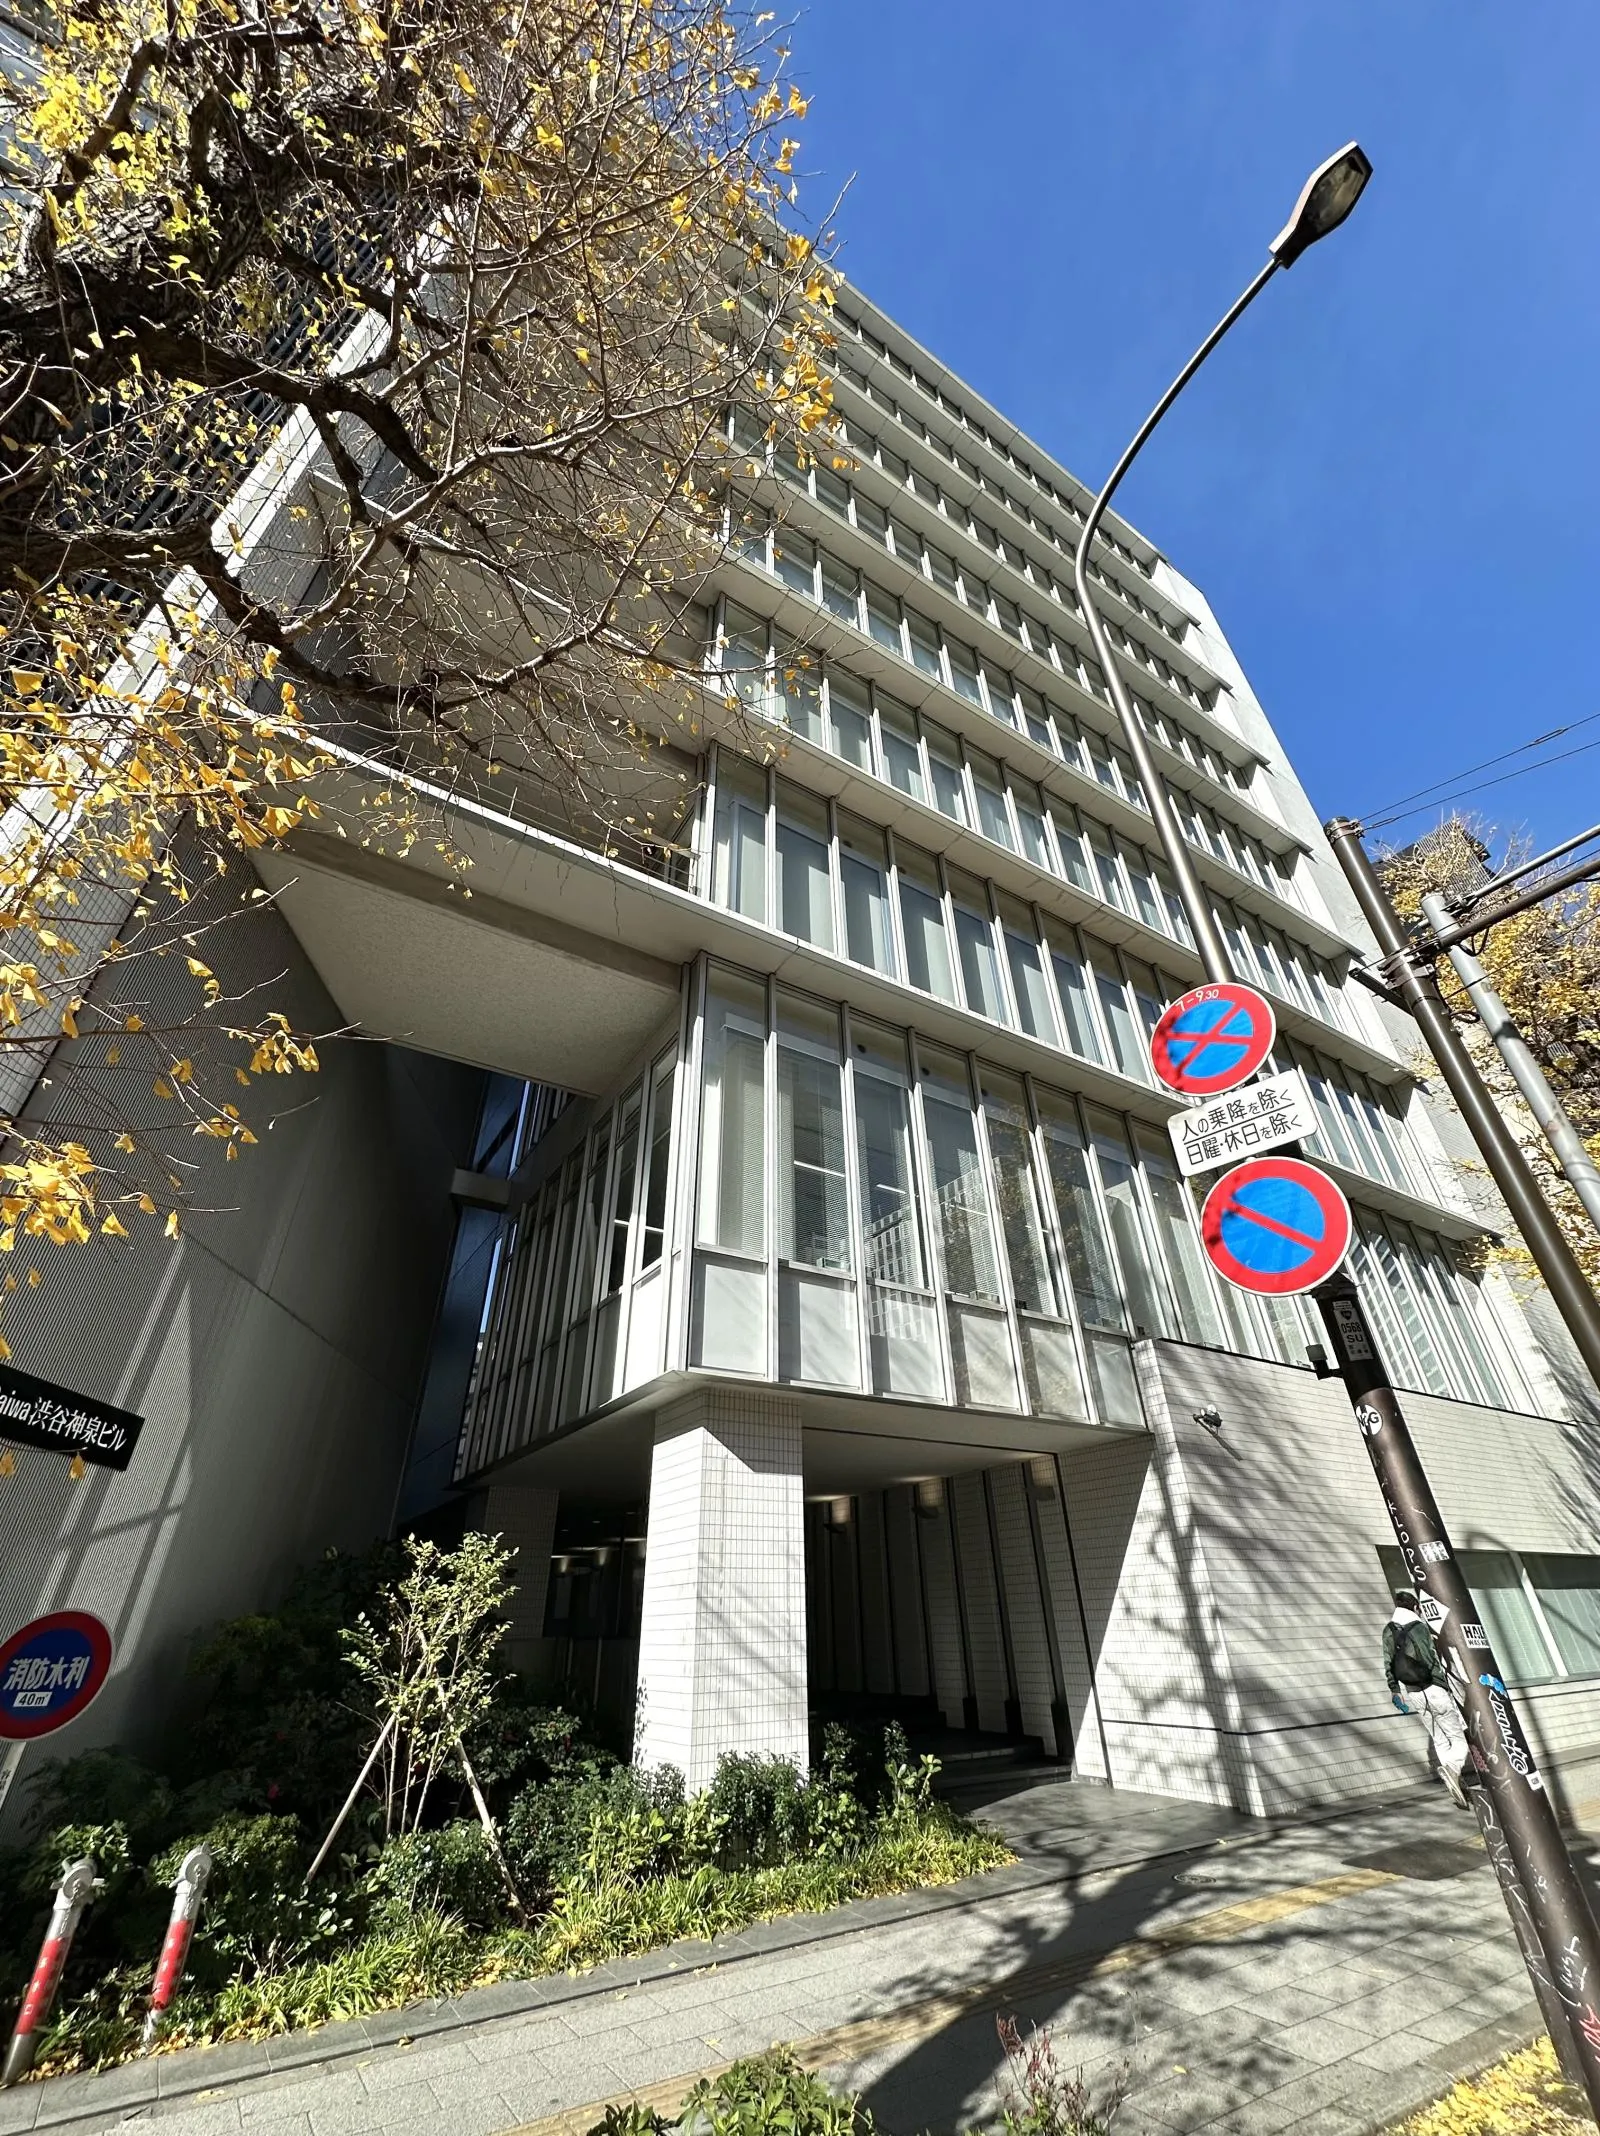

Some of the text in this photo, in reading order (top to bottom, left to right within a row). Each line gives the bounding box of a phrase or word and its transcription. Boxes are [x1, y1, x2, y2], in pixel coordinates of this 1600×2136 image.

[1182, 1088, 1293, 1142] 人の乗降を除く
[1347, 1334, 1364, 1343] SU
[0, 1387, 127, 1451] aiwa渋谷神泉ビル
[3, 1656, 90, 1690] 消防水利
